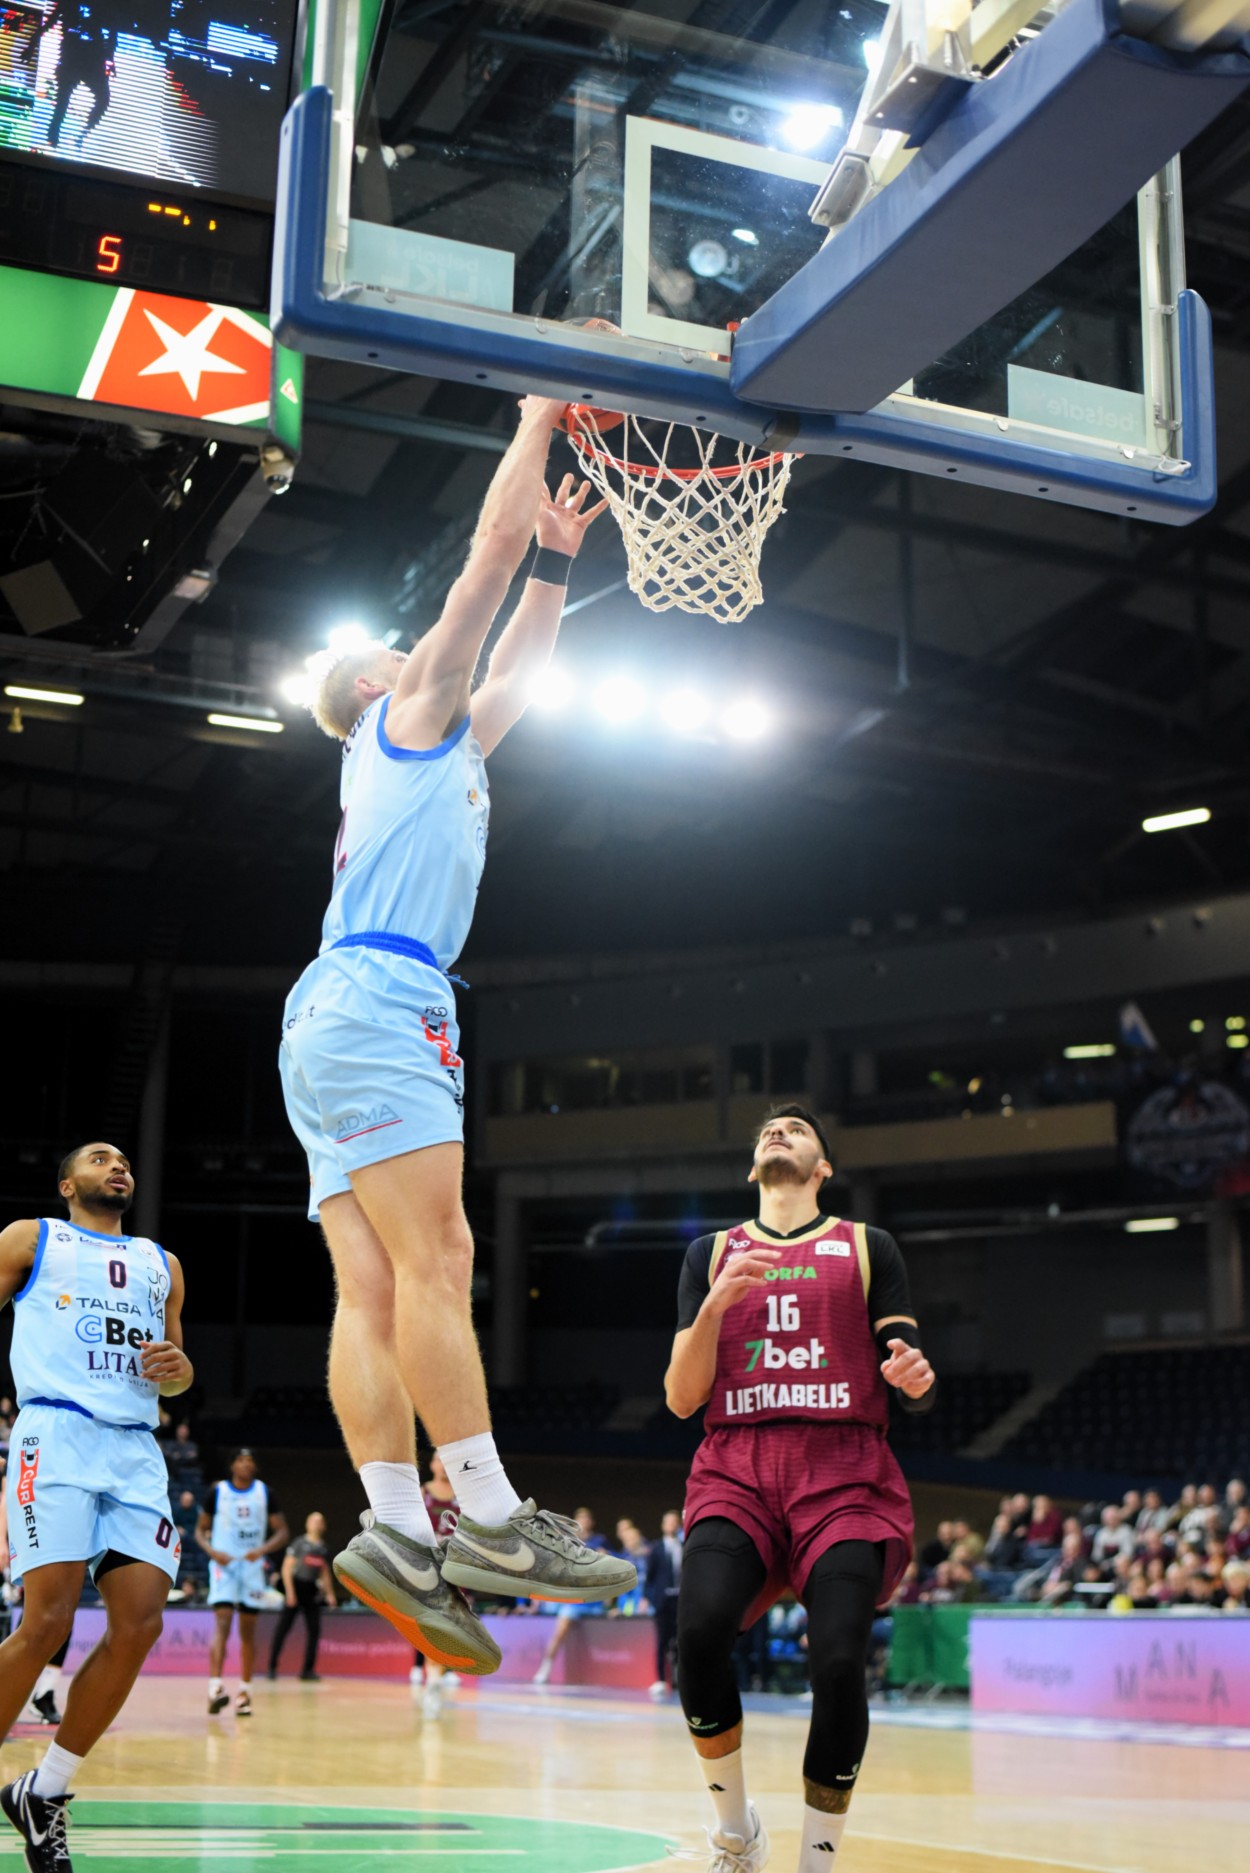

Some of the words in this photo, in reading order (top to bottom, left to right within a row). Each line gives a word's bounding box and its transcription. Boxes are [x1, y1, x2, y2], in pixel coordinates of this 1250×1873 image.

[97, 236, 122, 272] 5
[338, 1103, 400, 1139] ADMA
[109, 1260, 126, 1289] 0
[764, 1266, 817, 1281] ORFA
[76, 1297, 141, 1316] TALGA
[766, 1294, 800, 1332] 16
[75, 1314, 153, 1350] CBet
[86, 1350, 141, 1377] LITA
[745, 1338, 828, 1372] 7bet.
[726, 1382, 850, 1416] LIETKABELIS
[155, 1517, 174, 1549] 0
